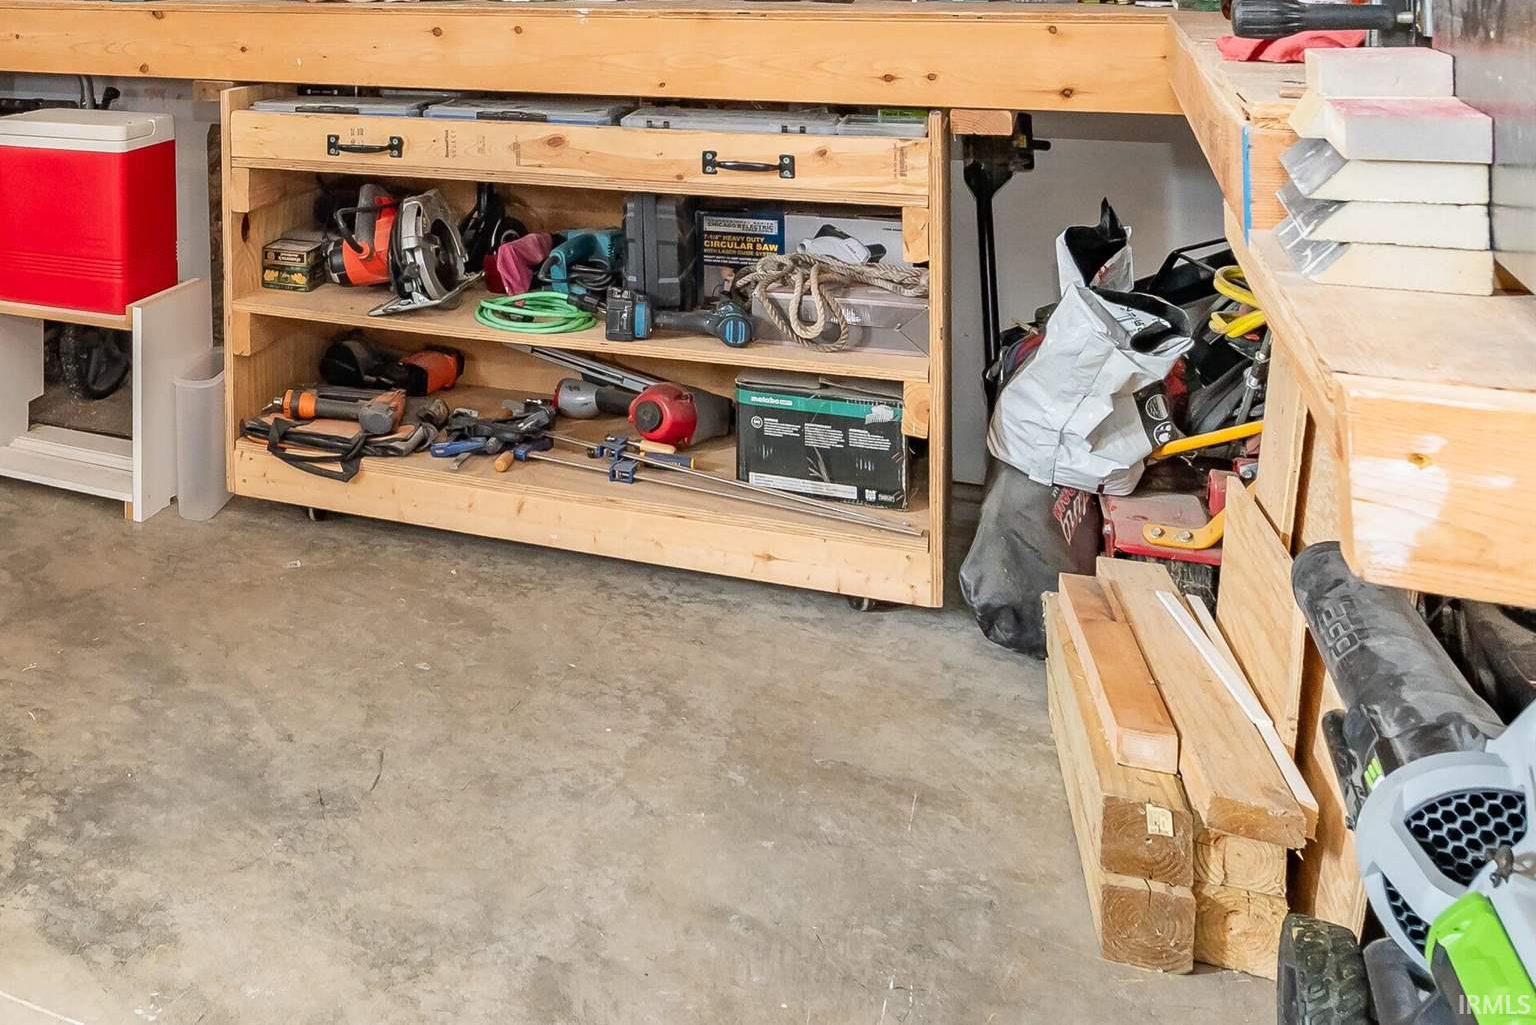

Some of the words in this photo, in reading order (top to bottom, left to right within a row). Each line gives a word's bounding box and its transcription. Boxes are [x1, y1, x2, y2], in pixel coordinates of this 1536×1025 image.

[704, 240, 753, 250] CIRCULAR
[755, 243, 779, 252] SAW
[750, 395, 779, 404] metabo
